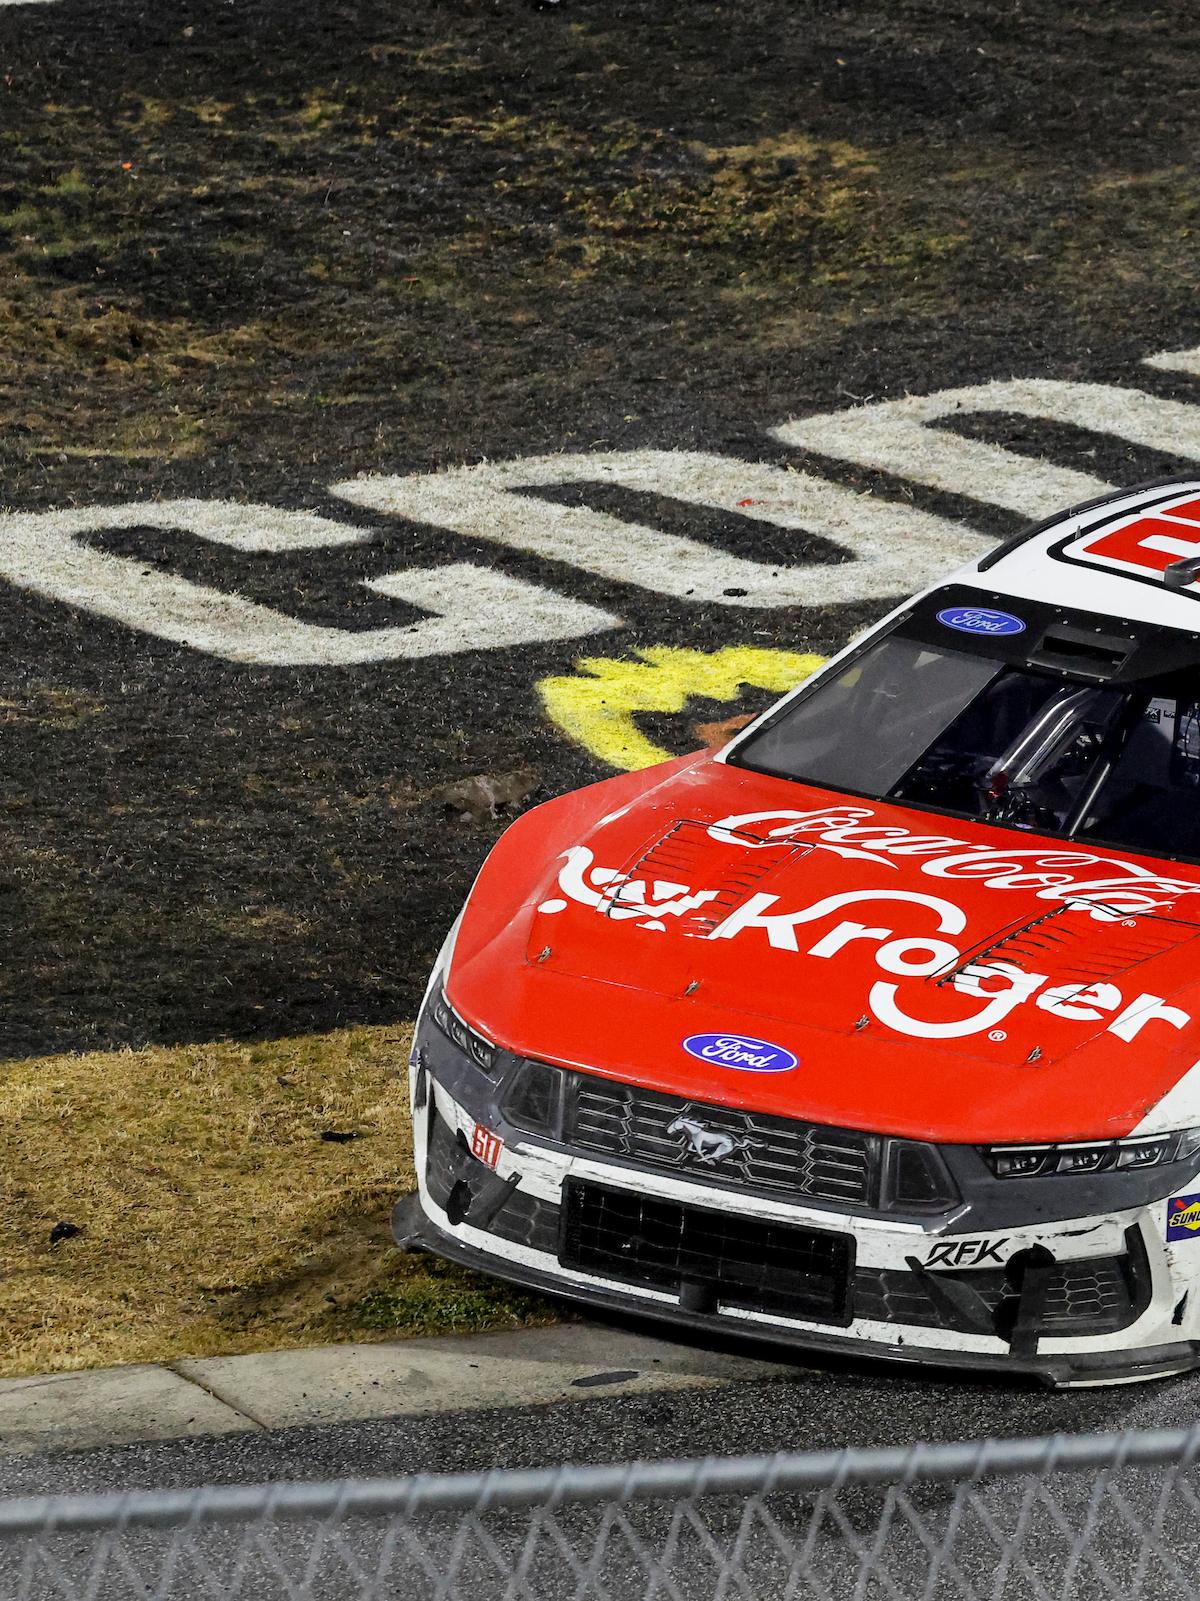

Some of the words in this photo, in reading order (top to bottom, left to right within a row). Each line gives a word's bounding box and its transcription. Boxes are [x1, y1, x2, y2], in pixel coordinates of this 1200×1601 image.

[949, 609, 1011, 633] Ford
[711, 889, 1191, 1042] Kroger
[700, 1037, 780, 1069] Ford
[471, 1122, 504, 1172] 60
[923, 1238, 1011, 1266] RFK
